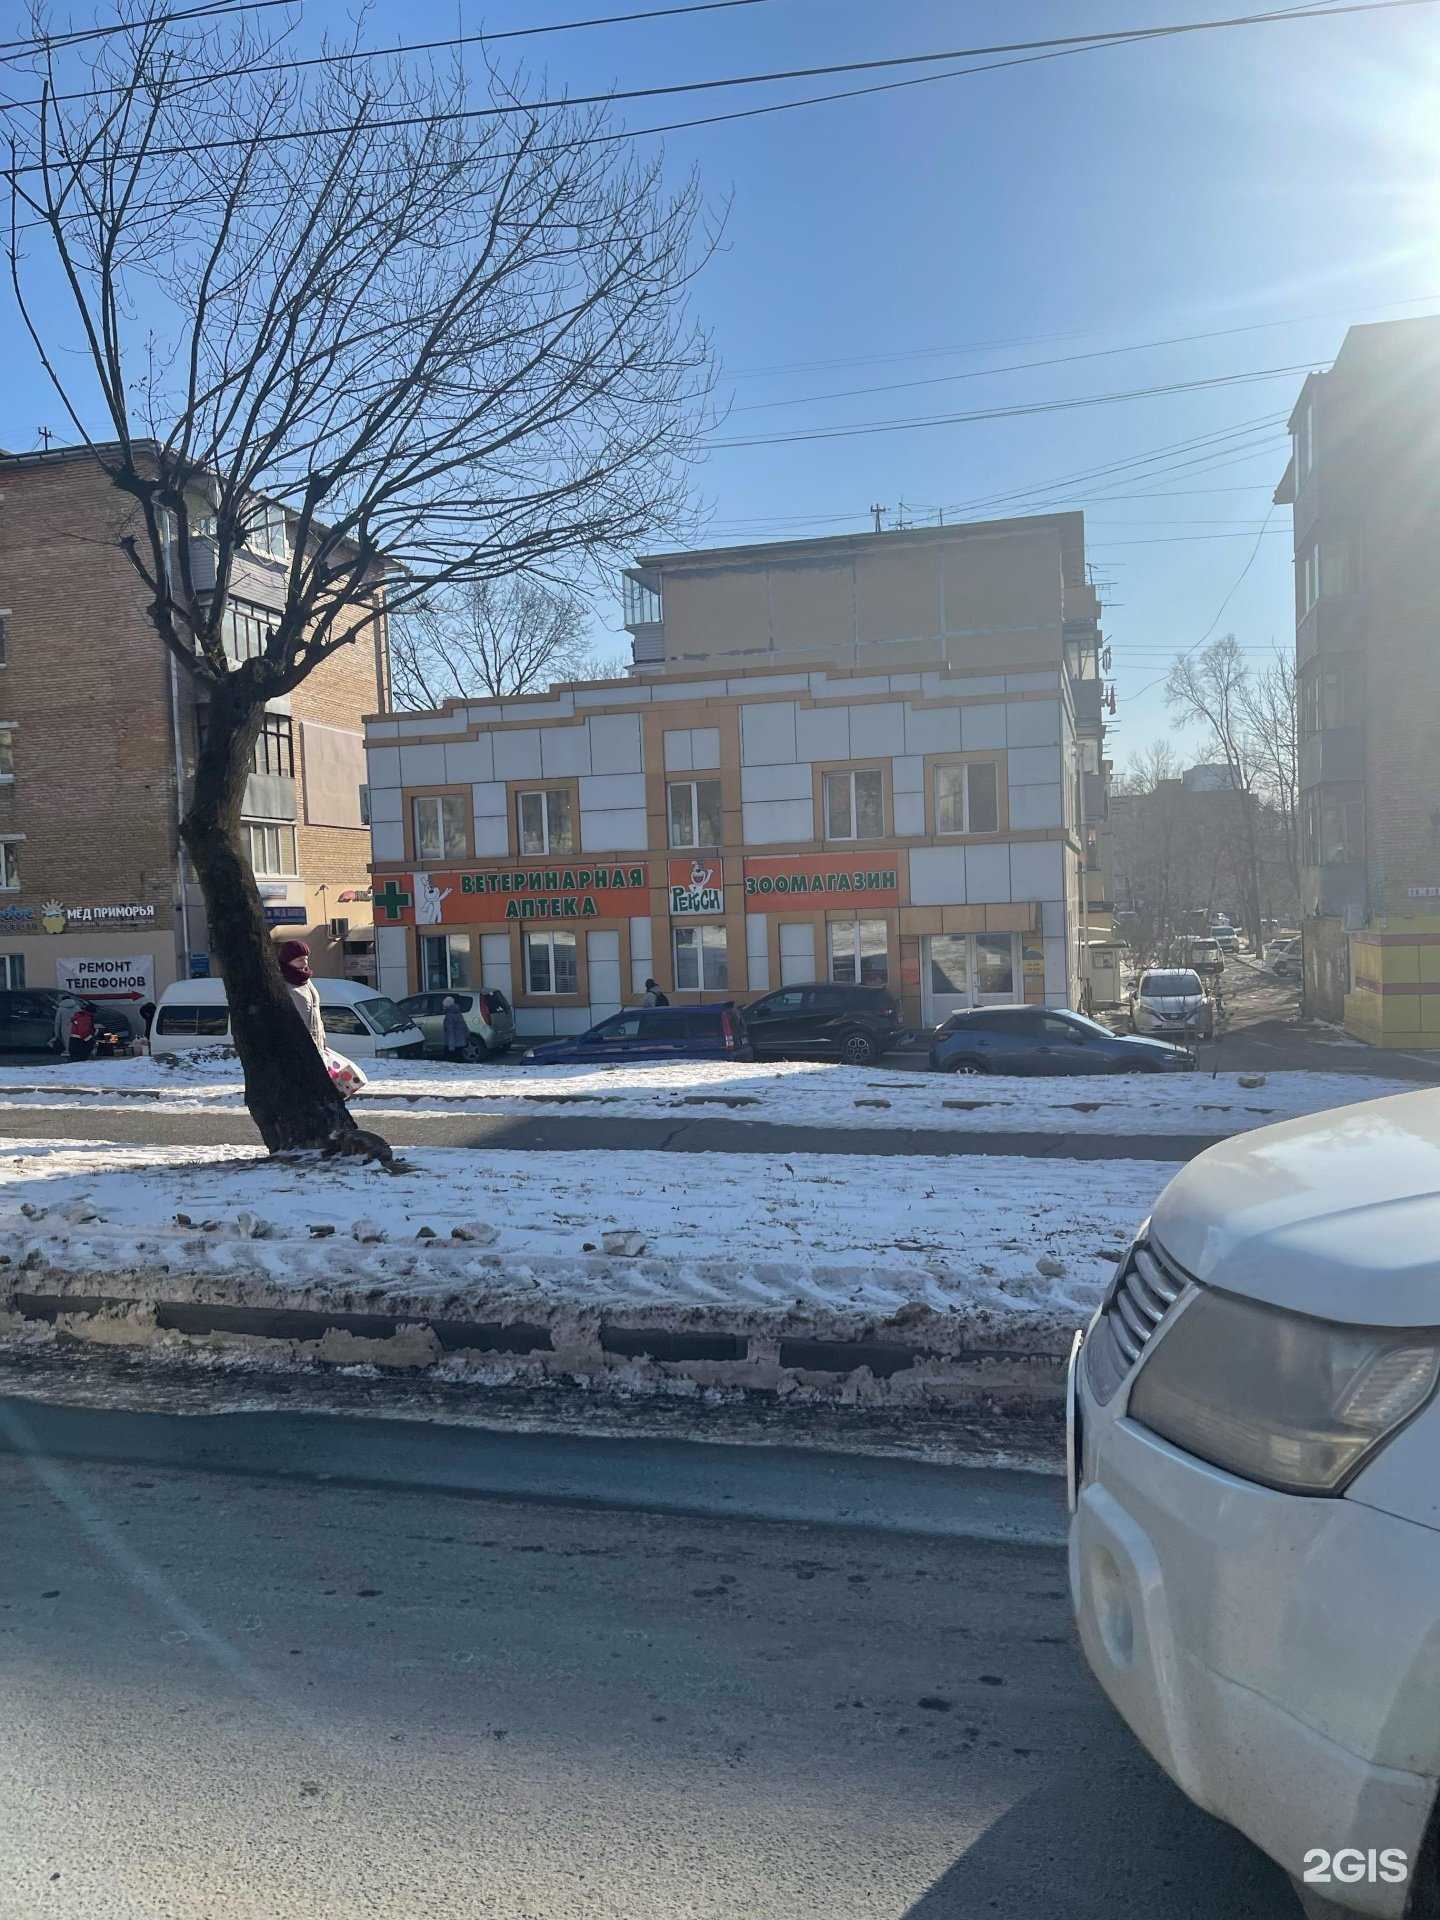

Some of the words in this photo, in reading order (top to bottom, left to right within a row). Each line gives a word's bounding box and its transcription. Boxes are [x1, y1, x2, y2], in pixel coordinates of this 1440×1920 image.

[460, 868, 645, 894] ВЕТЕРИНАРНАЯ
[745, 871, 896, 895] ЗООМАГАЗИН
[93, 905, 154, 919] ПРИМОРЬЯ
[505, 896, 598, 919] АПТЕКА
[78, 961, 132, 973] РЕМОНТ
[65, 976, 146, 989] ТЕЛЕФОНОВ
